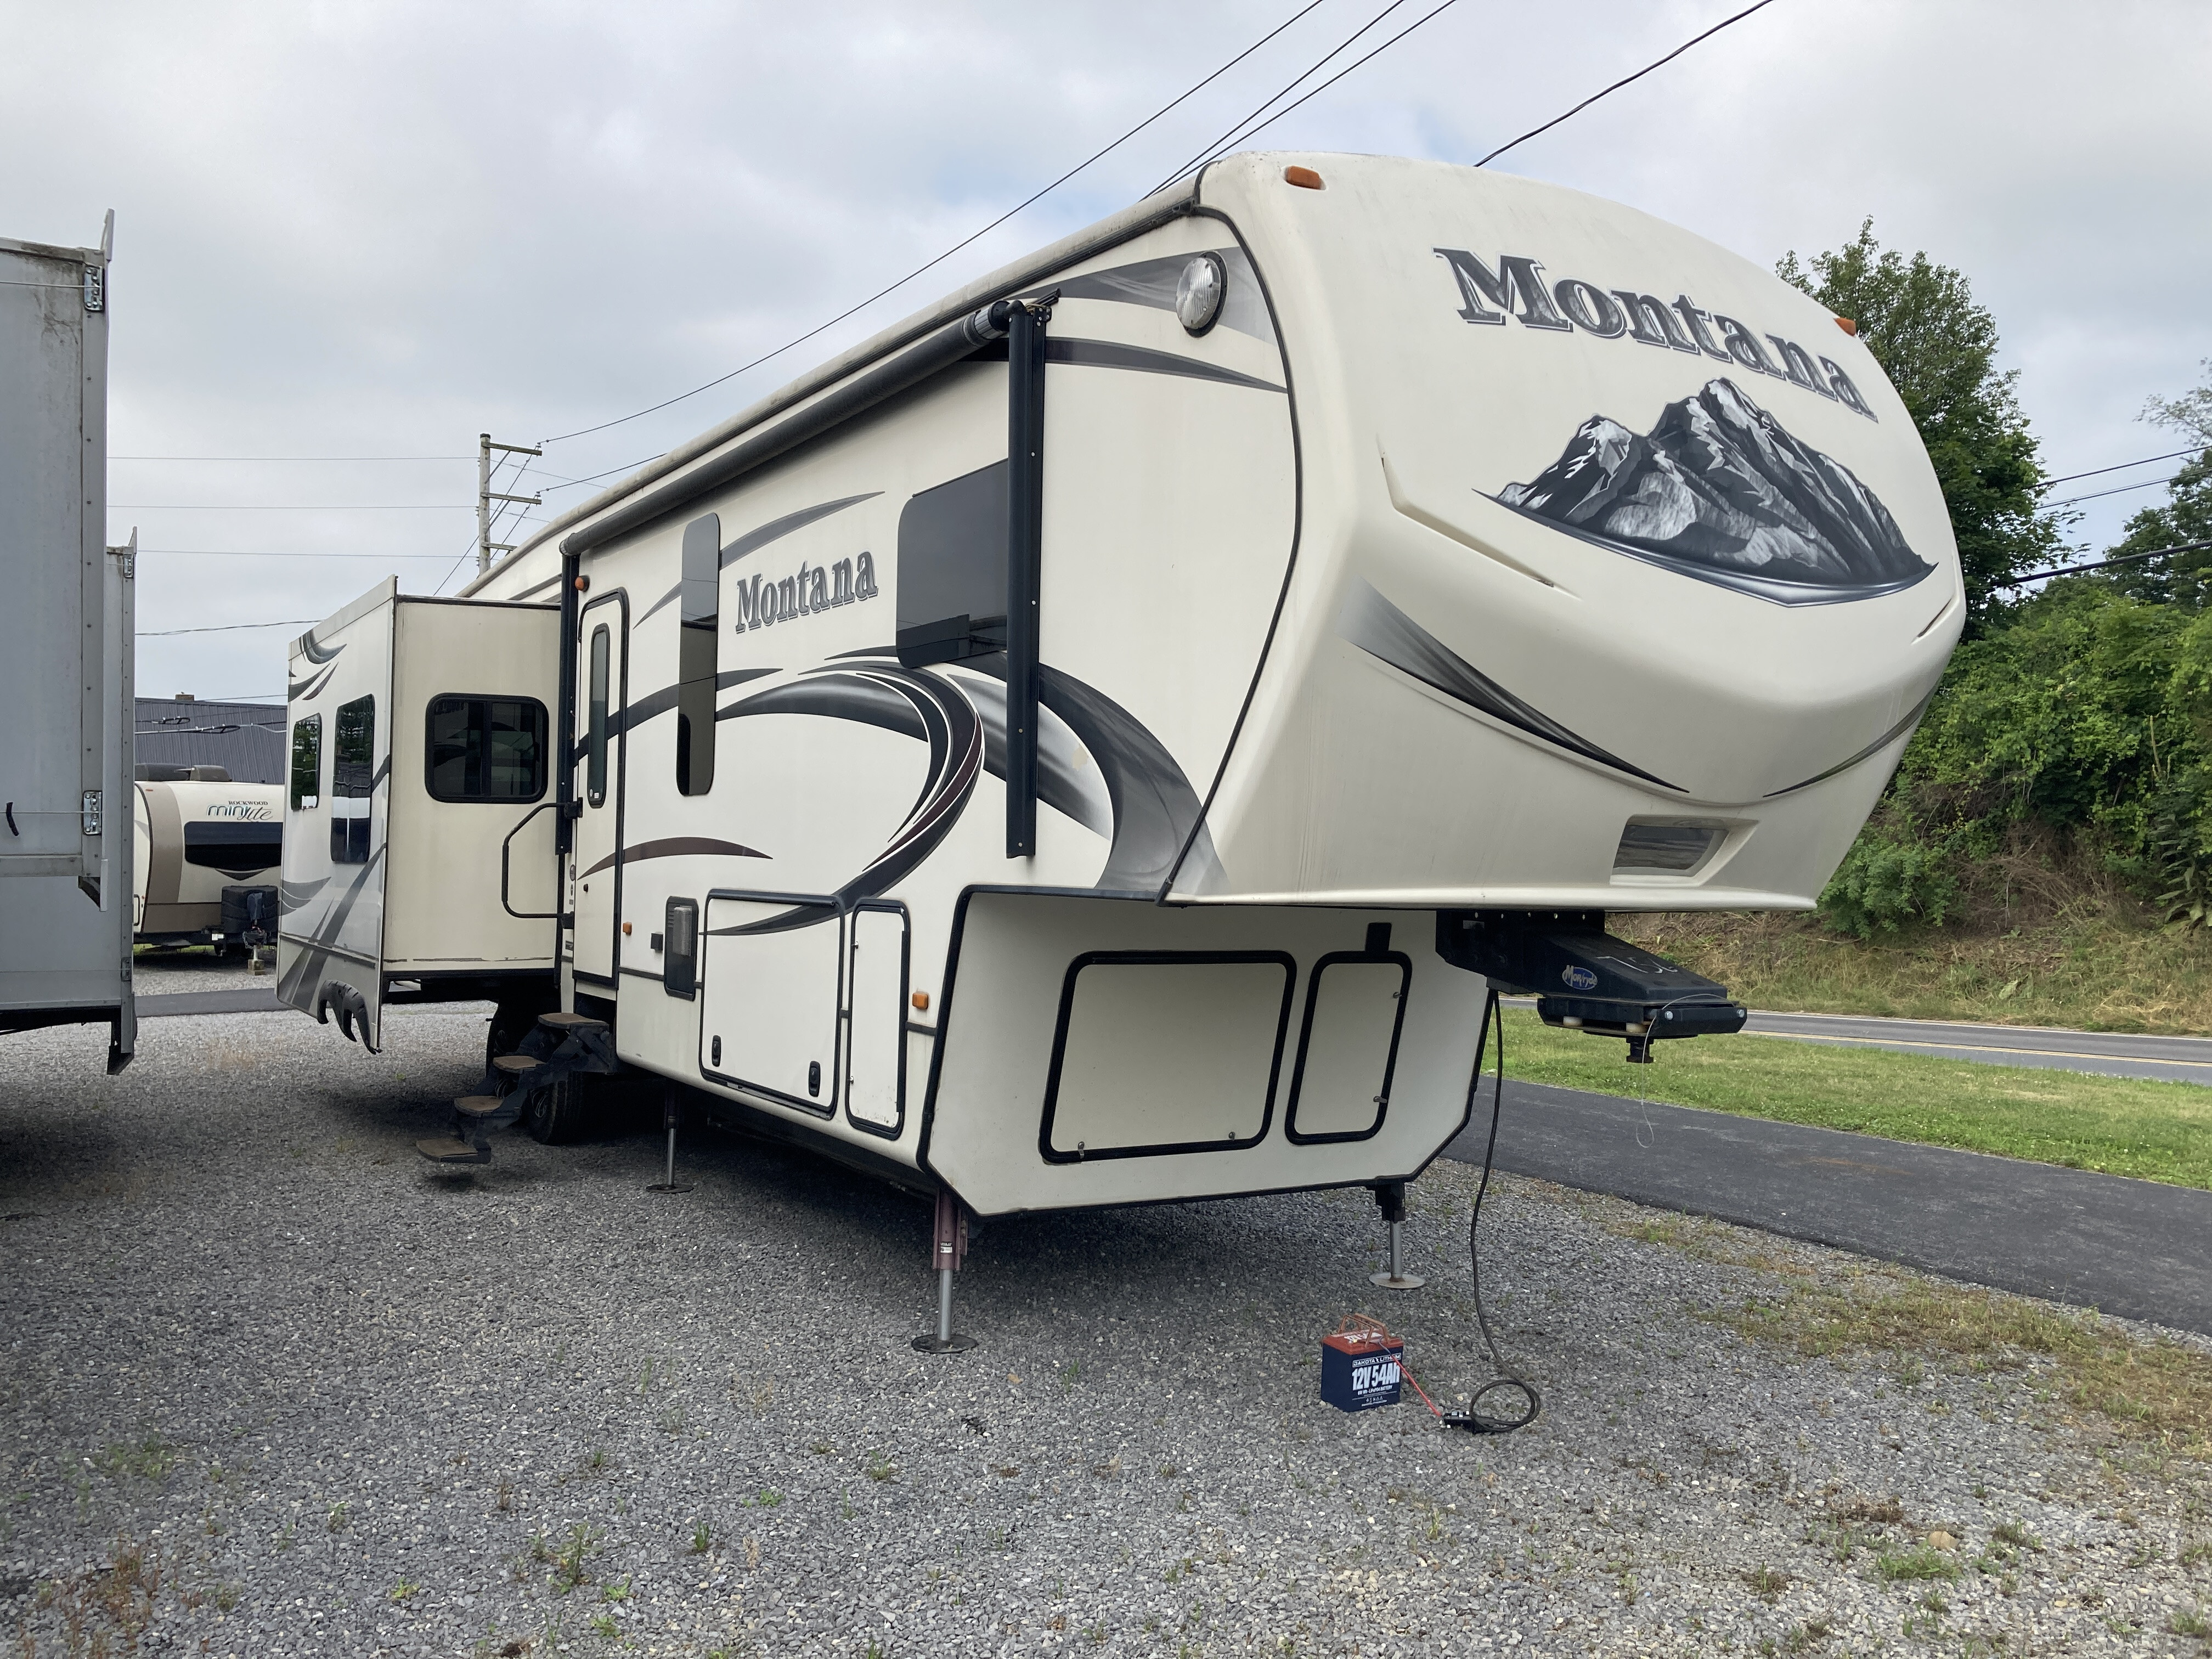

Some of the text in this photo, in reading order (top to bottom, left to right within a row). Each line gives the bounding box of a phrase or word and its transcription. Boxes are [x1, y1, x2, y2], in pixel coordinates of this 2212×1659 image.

[1432, 246, 1878, 423] Montana
[736, 550, 878, 634] Montana
[1352, 1362, 1401, 1391] 12V 54Ah
